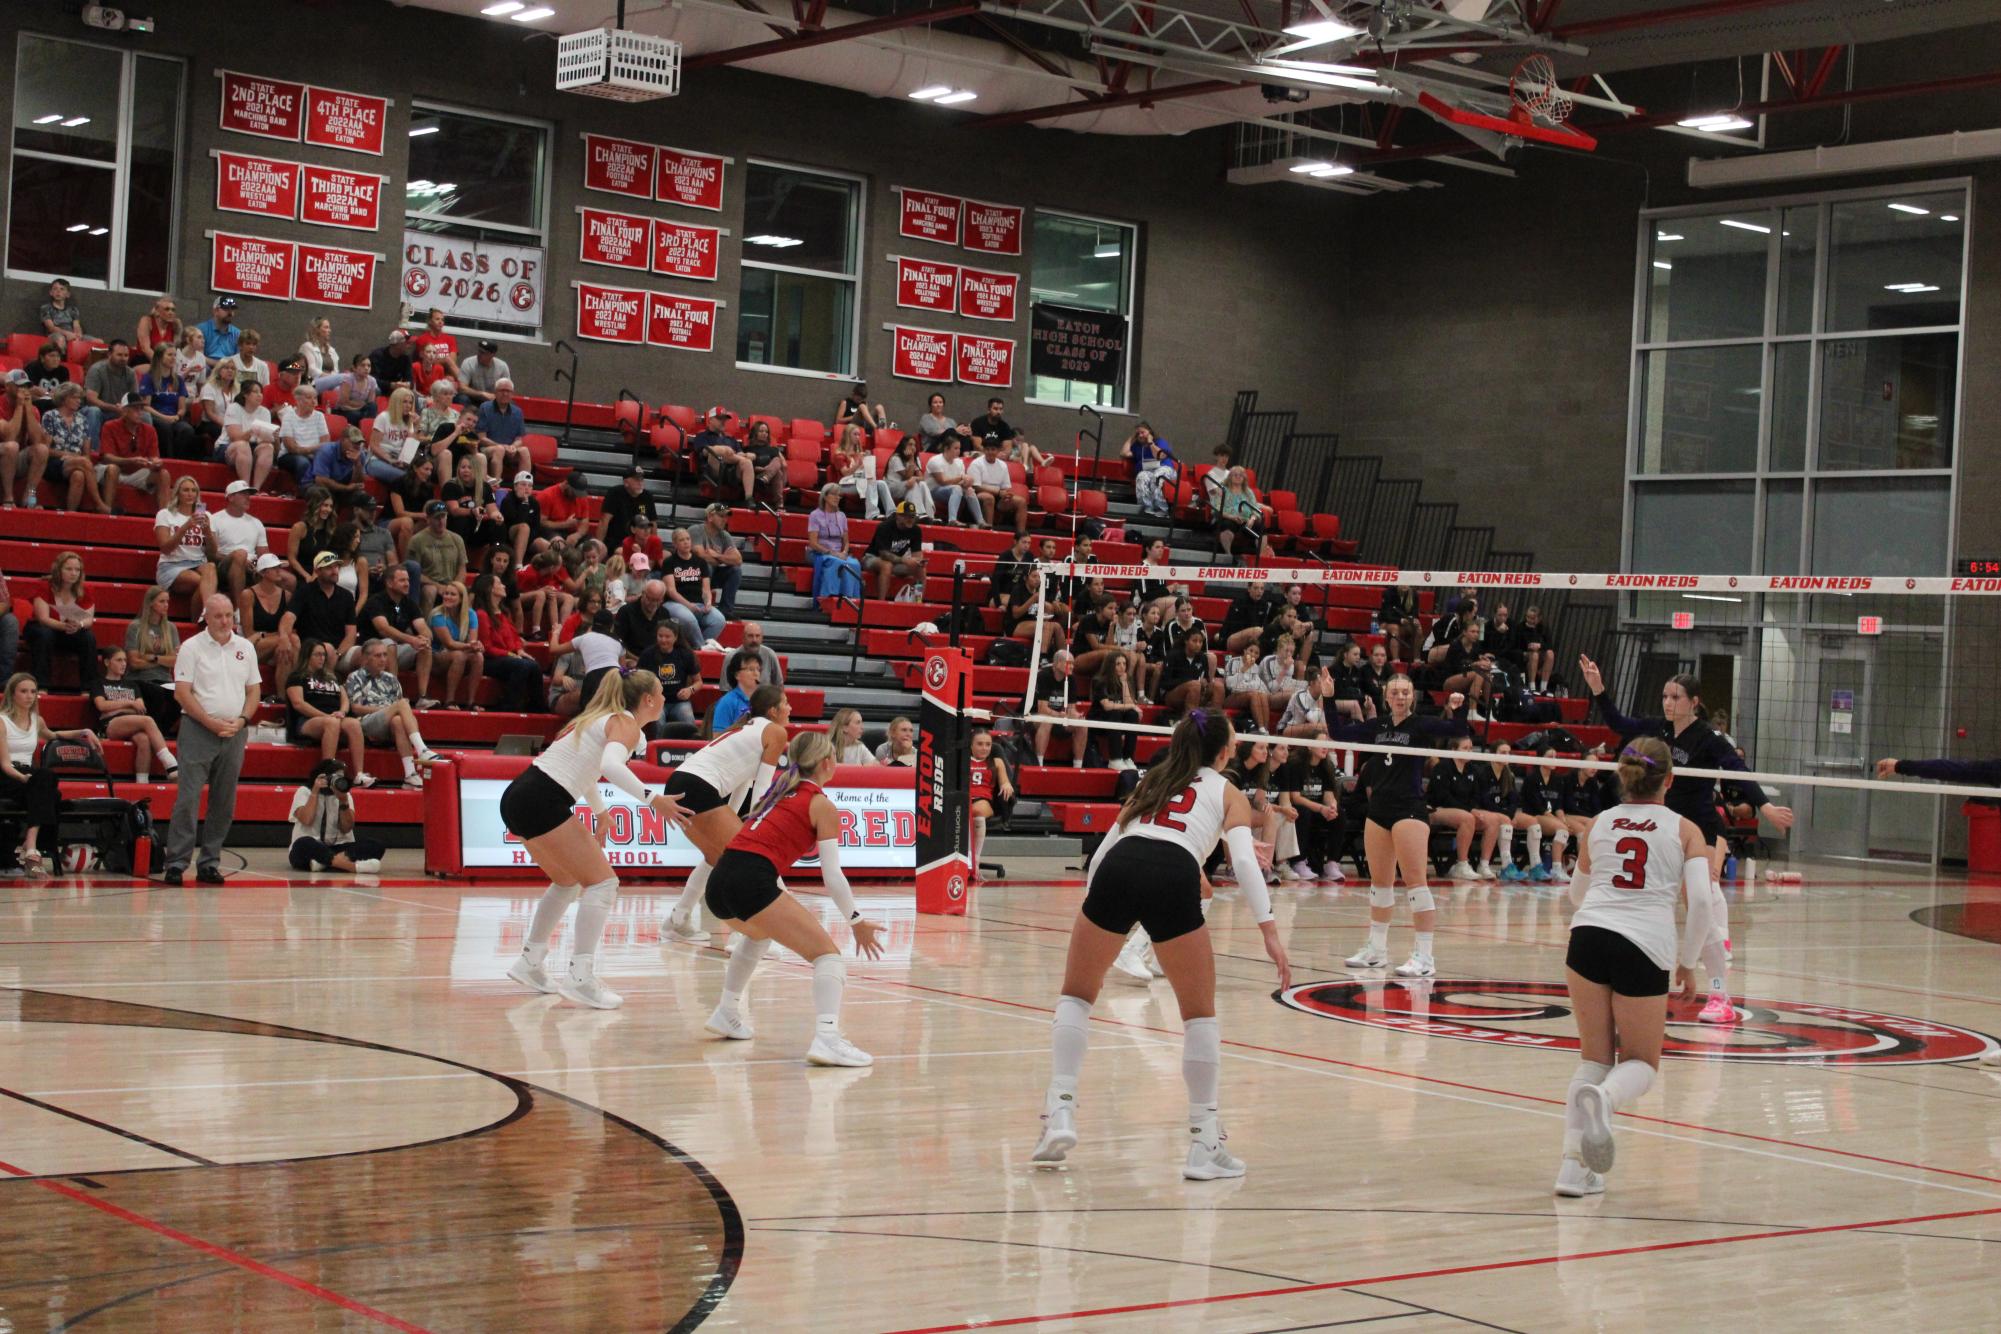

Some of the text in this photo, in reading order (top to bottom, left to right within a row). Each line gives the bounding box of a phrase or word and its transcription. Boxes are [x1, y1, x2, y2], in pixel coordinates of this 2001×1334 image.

[251, 82, 275, 94] STATE
[232, 84, 292, 111] 2ND PLACE
[336, 97, 360, 108] STATE
[246, 102, 276, 116] 2021 AA
[317, 100, 375, 125] 4TH PLACE
[234, 110, 287, 126] MARCHING BAND
[328, 116, 363, 129] 2022AAA
[250, 121, 269, 131] EATON
[326, 125, 365, 138] BOYS TRACK
[336, 135, 354, 144] EATON
[612, 144, 632, 153] STATE
[596, 147, 648, 170] CHAMPIONS
[681, 158, 701, 167] STATE
[248, 162, 272, 172] STATE
[666, 159, 715, 182] CHAMPIONS
[229, 164, 289, 189] CHAMPIONS
[331, 175, 355, 185] STATE
[607, 171, 634, 182] FOOTBALL
[675, 176, 704, 188] 2023 AAA
[241, 182, 276, 193] 2022AAA
[312, 177, 374, 202] THIRD PLACE
[612, 179, 627, 188] EATON
[676, 184, 702, 195] BASEBALL
[240, 191, 276, 203] WRESTLING
[326, 195, 358, 207] 2022AA
[682, 193, 696, 201] EATON
[924, 197, 939, 205] STATE
[248, 200, 267, 209] EATON
[315, 202, 367, 216] MARCHING BAND
[906, 199, 955, 220] FINAL FOUR
[332, 212, 350, 221] EATON
[607, 217, 627, 227] STATE
[971, 211, 1014, 229] CHAMPIONS
[590, 219, 643, 243] FINAL FOUR
[676, 230, 696, 238] STATE
[923, 227, 936, 235] EATON
[982, 233, 1003, 241] SOFTBALL
[242, 242, 266, 253] STATE
[601, 236, 631, 248] 2022AAA
[660, 233, 708, 253] 3RD PLACE
[985, 240, 999, 248] EATON
[598, 245, 632, 256] VOLLEYBALL
[669, 248, 699, 259] 2023 AAA
[224, 245, 284, 270] CHAMPIONS
[325, 253, 348, 264] STATE
[406, 245, 536, 280] CLASS OF
[607, 253, 622, 261] EATON
[666, 255, 700, 266] BOYS TRACK
[236, 264, 271, 275] 2022AAA
[306, 256, 365, 279] CHAMPIONS
[921, 266, 935, 274] STATE
[237, 272, 269, 283] BASEBALL
[317, 273, 352, 285] 2022AAA
[903, 268, 952, 287] FINAL FOUR
[243, 281, 261, 290] EATON
[318, 282, 350, 293] SOFTBALL
[439, 276, 500, 302] 2026
[964, 279, 1012, 297] FINAL FOUR
[324, 291, 342, 300] EATON
[601, 292, 623, 301] STATE
[915, 288, 940, 297] VOLLEYBALL
[585, 294, 638, 315] CHAMPIONS
[675, 302, 691, 310] STATE
[977, 299, 1000, 307] WRESTLING
[595, 311, 626, 322] 2023 AAA
[654, 304, 709, 325] FINAL FOUR
[595, 319, 626, 330] WRESTLING
[1057, 320, 1100, 334] EATON
[602, 328, 617, 336] EATON
[669, 327, 691, 336] FOOTBALL
[672, 334, 687, 342] EATON
[916, 334, 934, 342] STATE
[1032, 329, 1121, 350] HIGH SCHOOL
[901, 336, 946, 356] CHAMPIONS
[976, 340, 994, 349] STATE
[962, 344, 1007, 363] FINAL FOUR
[1047, 344, 1107, 361] CLASS OF
[911, 360, 934, 368] BASEBALL
[987, 360, 997, 368] AAA
[1061, 359, 1090, 371] 2029
[1085, 565, 1149, 577] EATON REDS
[1970, 561, 1999, 573] 6:54
[1199, 568, 1269, 579] EATON REDS
[1322, 570, 1398, 582] EATON REDS
[1457, 573, 1541, 585] EATON REDS
[1606, 575, 1699, 587] EATON REDS
[1769, 577, 1872, 590] EATON REDS
[917, 729, 935, 838] EATON
[933, 755, 944, 813] REDS
[972, 772, 983, 785] 9
[604, 789, 614, 797] to
[835, 792, 889, 805] Home of the
[1611, 818, 1658, 832] Reds
[1611, 836, 1648, 889] 3
[1373, 1018, 1558, 1044] REDS
